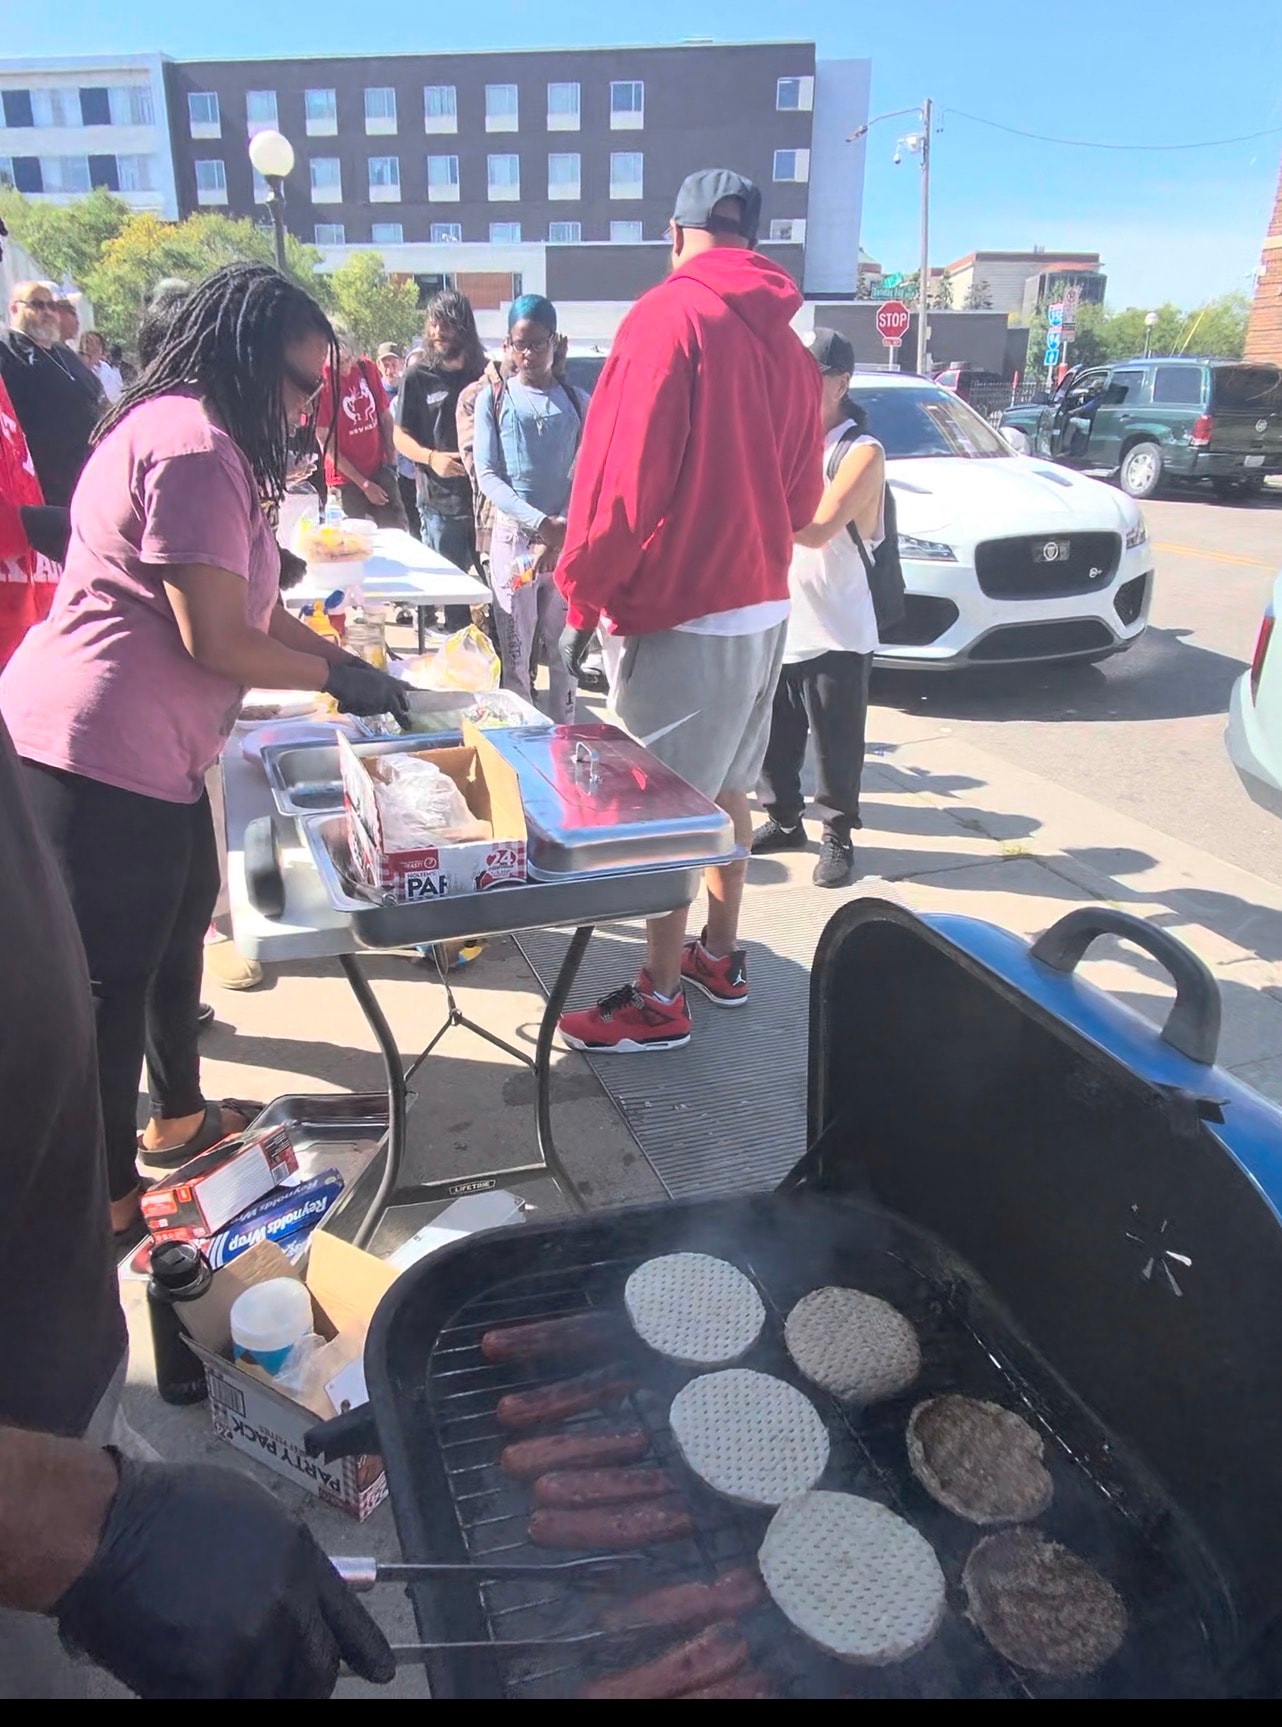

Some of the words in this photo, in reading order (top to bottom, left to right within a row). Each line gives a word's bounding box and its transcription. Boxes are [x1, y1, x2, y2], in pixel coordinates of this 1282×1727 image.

[879, 313, 907, 327] STOP
[490, 850, 514, 867] 24
[455, 1181, 491, 1193] LIFETIME
[266, 1196, 327, 1234] Reynolds
[228, 1225, 267, 1251] Wrap
[231, 1415, 278, 1457] PACK
[281, 1449, 341, 1493] PARTY
